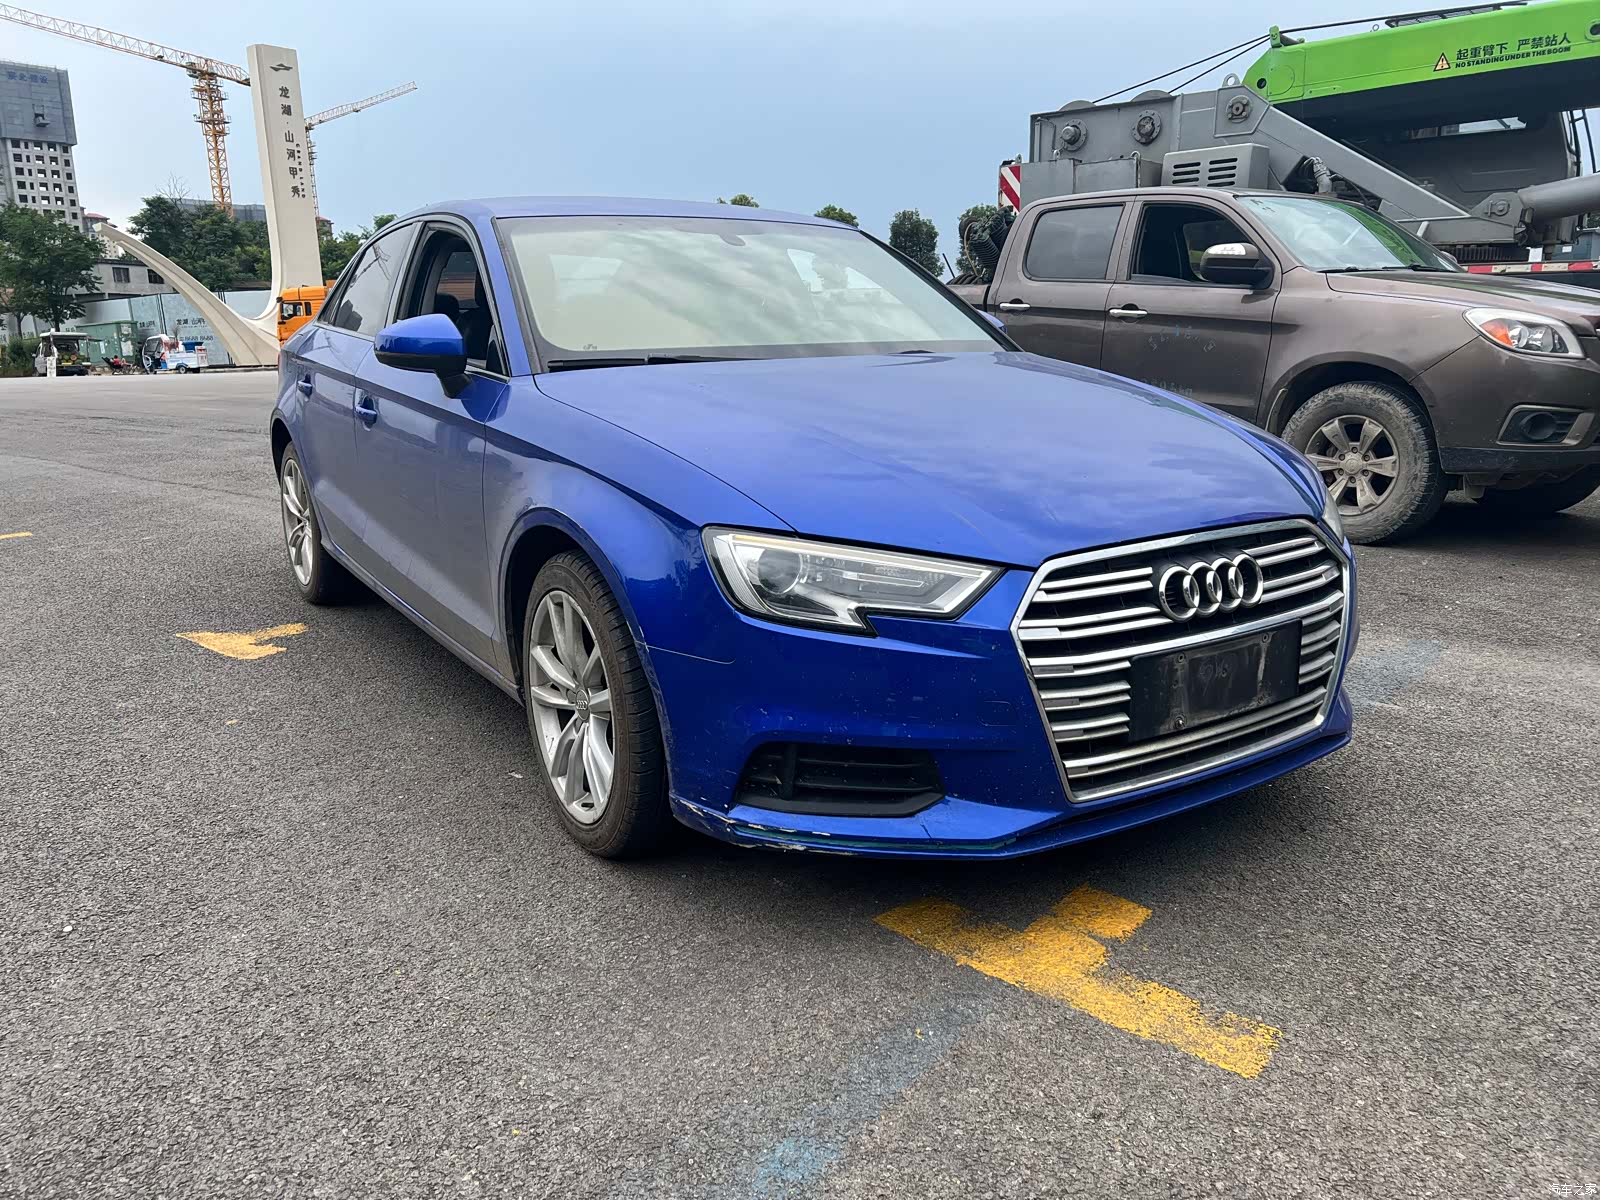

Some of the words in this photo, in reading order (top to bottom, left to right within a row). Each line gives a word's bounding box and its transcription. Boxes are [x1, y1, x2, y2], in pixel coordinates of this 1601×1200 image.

[1456, 42, 1509, 61] 起重臂下
[1517, 32, 1571, 52] 严禁站人
